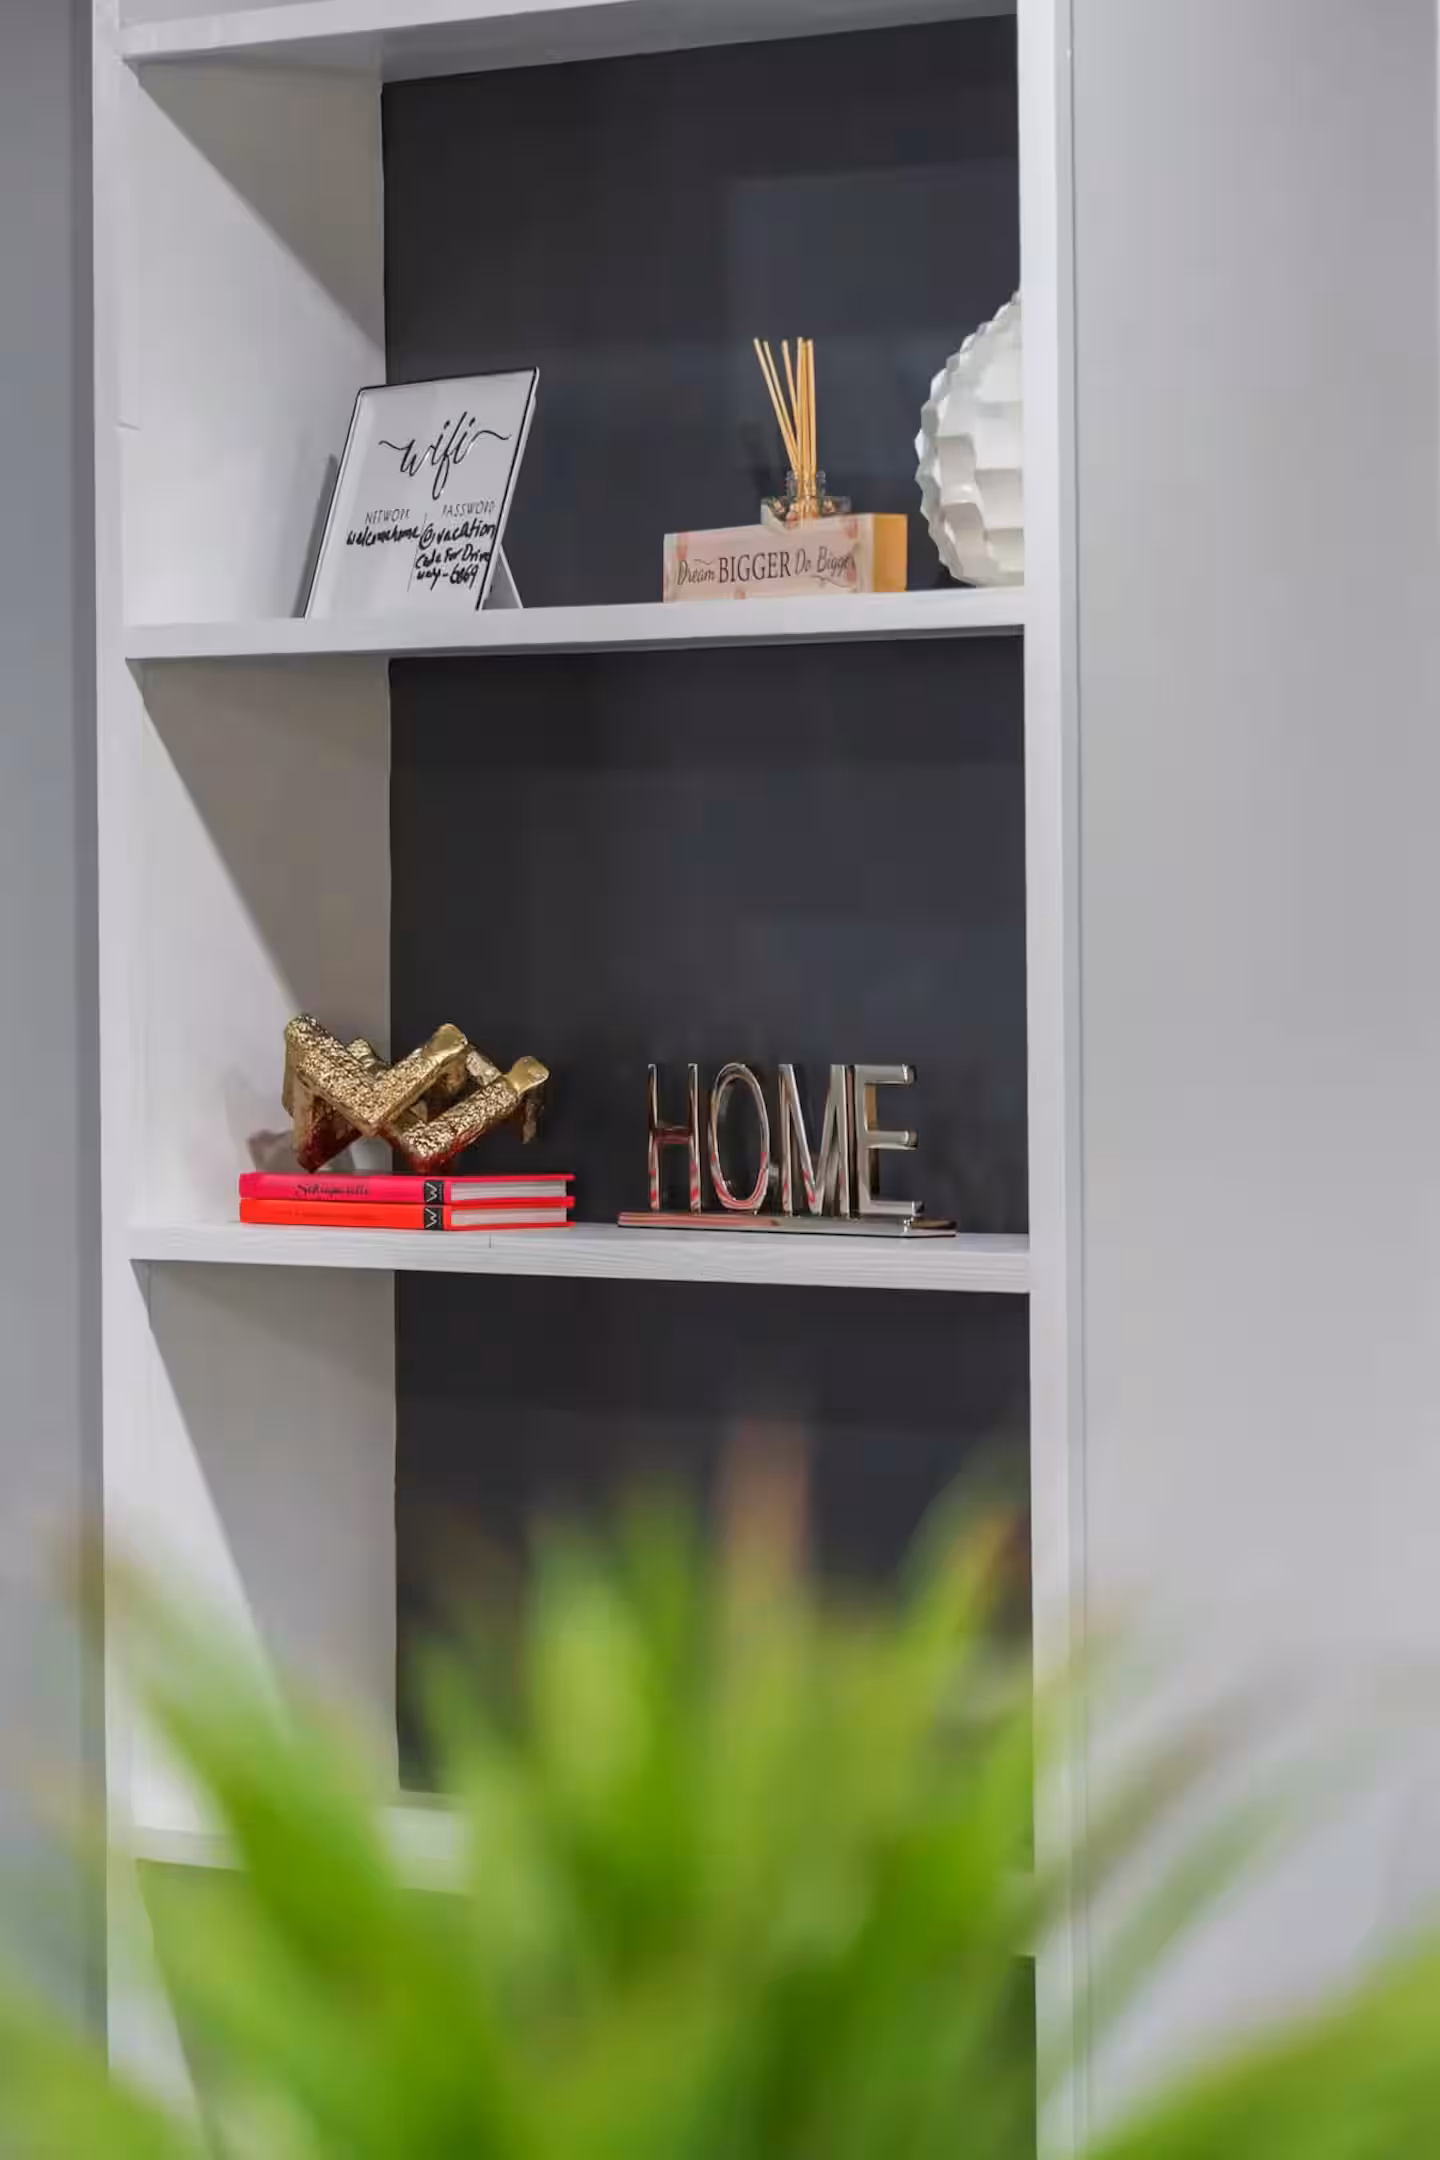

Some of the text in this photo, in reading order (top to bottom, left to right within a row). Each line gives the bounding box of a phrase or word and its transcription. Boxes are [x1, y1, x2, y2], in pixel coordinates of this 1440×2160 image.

[378, 411, 512, 501] wifi
[364, 508, 411, 525] NETWORK
[441, 500, 497, 519] PASSWORD
[677, 557, 716, 586] Dream
[718, 550, 793, 584] BIGGER
[794, 548, 812, 576] Do
[648, 1062, 926, 1219] HOME
